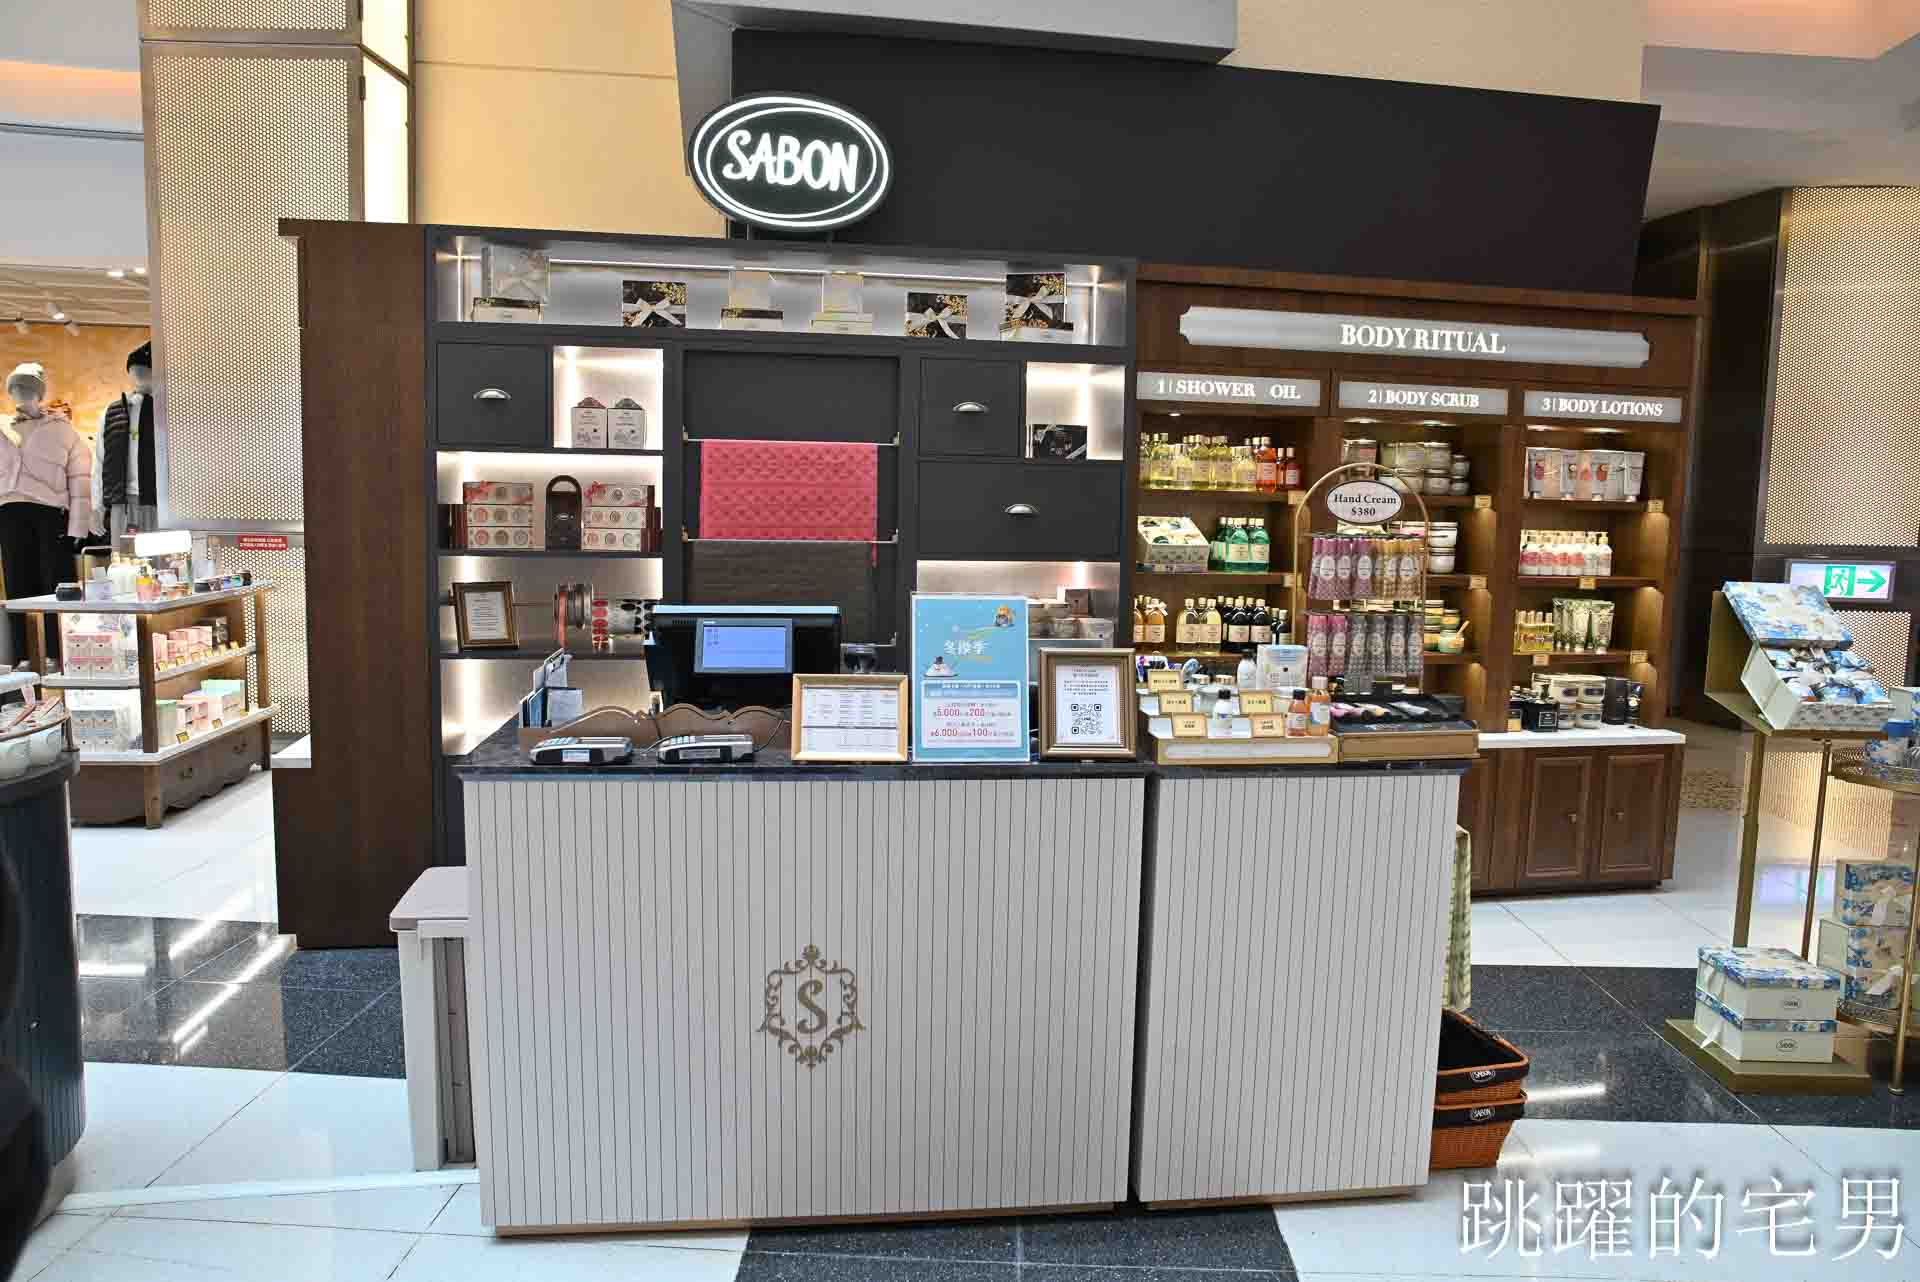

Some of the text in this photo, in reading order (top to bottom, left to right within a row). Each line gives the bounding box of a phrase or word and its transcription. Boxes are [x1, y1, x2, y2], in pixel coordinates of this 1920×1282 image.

[722, 129, 859, 194] SABON
[1340, 324, 1506, 354] BODY RITUAL
[1175, 380, 1256, 397] SHOWER
[1270, 384, 1301, 399] OIL
[1385, 390, 1430, 405] BODY
[1431, 392, 1480, 408] SCRUB
[1558, 398, 1599, 413] BODY
[1600, 401, 1664, 416] LOTIONS
[1334, 494, 1396, 504] Hand Cream
[1351, 507, 1376, 517] $380
[798, 980, 827, 1033] S
